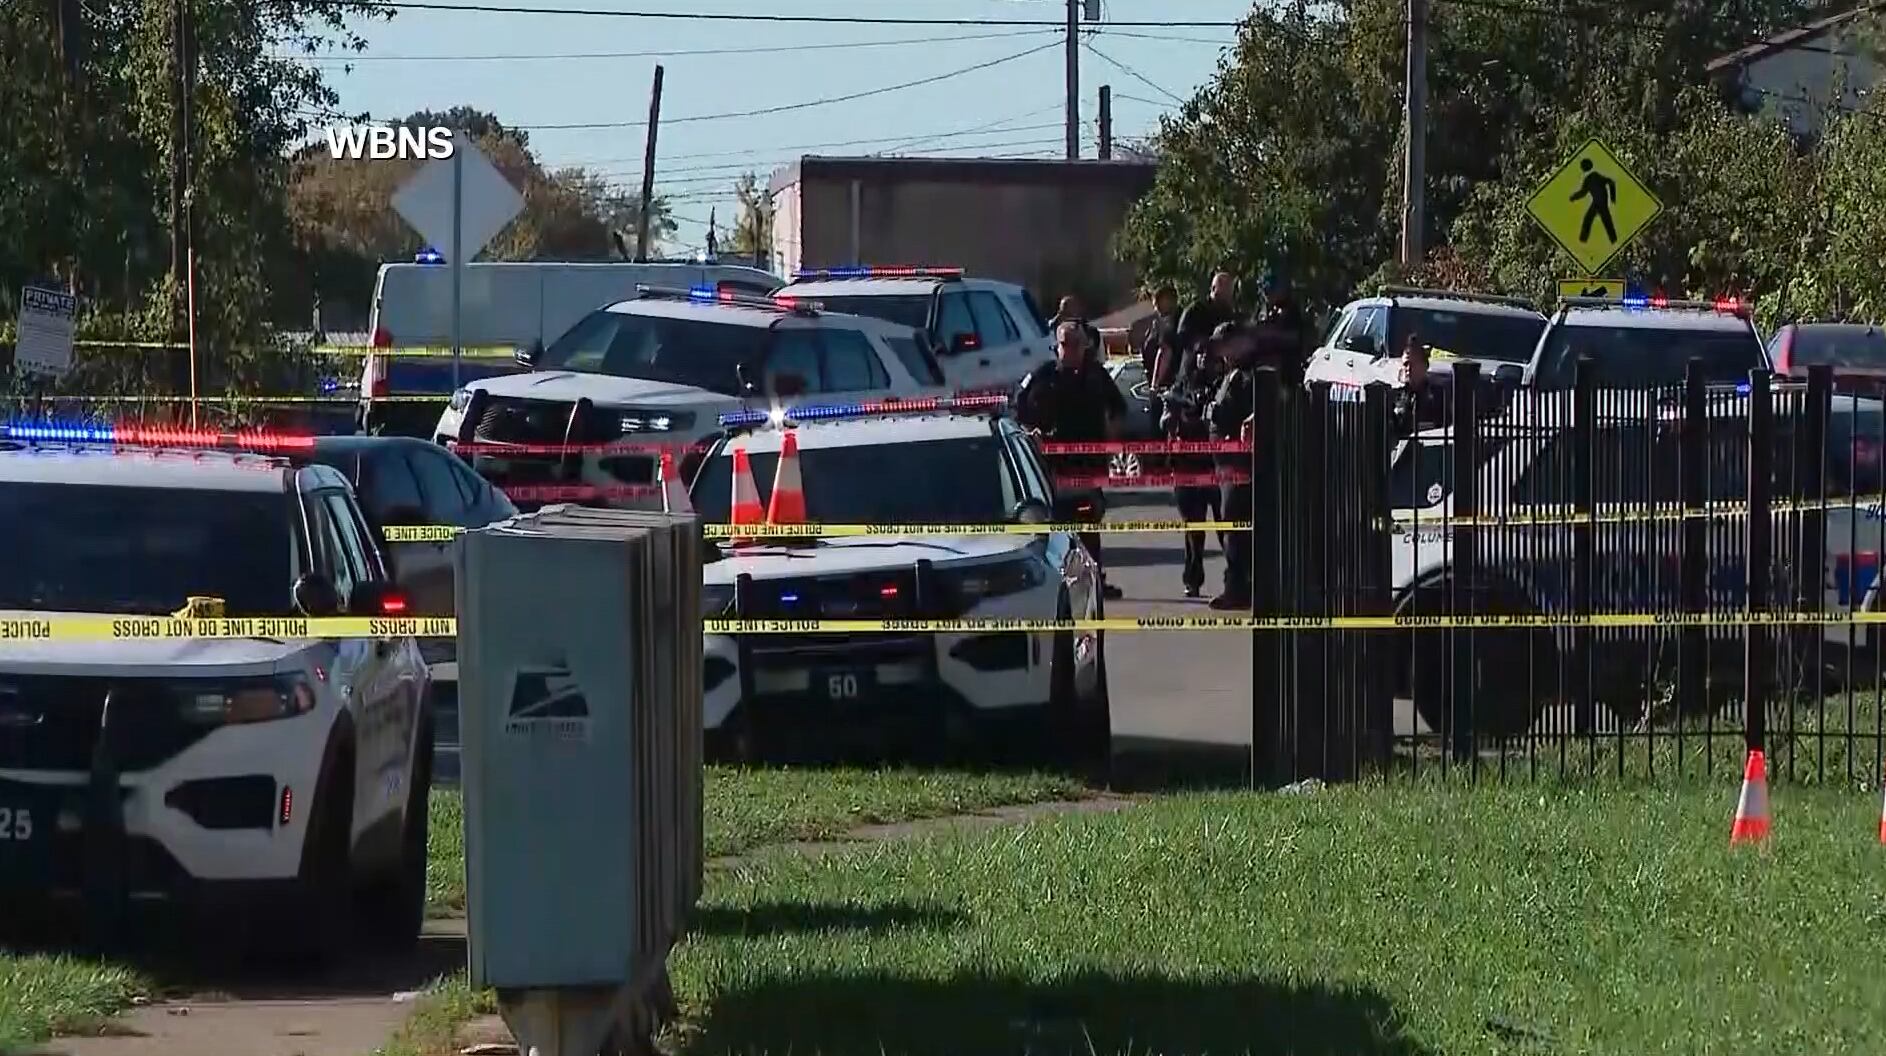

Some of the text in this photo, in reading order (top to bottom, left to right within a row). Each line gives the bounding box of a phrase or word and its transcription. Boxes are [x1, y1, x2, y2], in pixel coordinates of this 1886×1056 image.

[26, 289, 74, 309] PRIVATE
[421, 527, 454, 539] OLICE
[1, 620, 50, 639] POLICE
[113, 619, 308, 638] POLICE LINE DO NOT CROSS
[369, 619, 450, 636] NOT CROSS
[0, 807, 33, 841] 25
